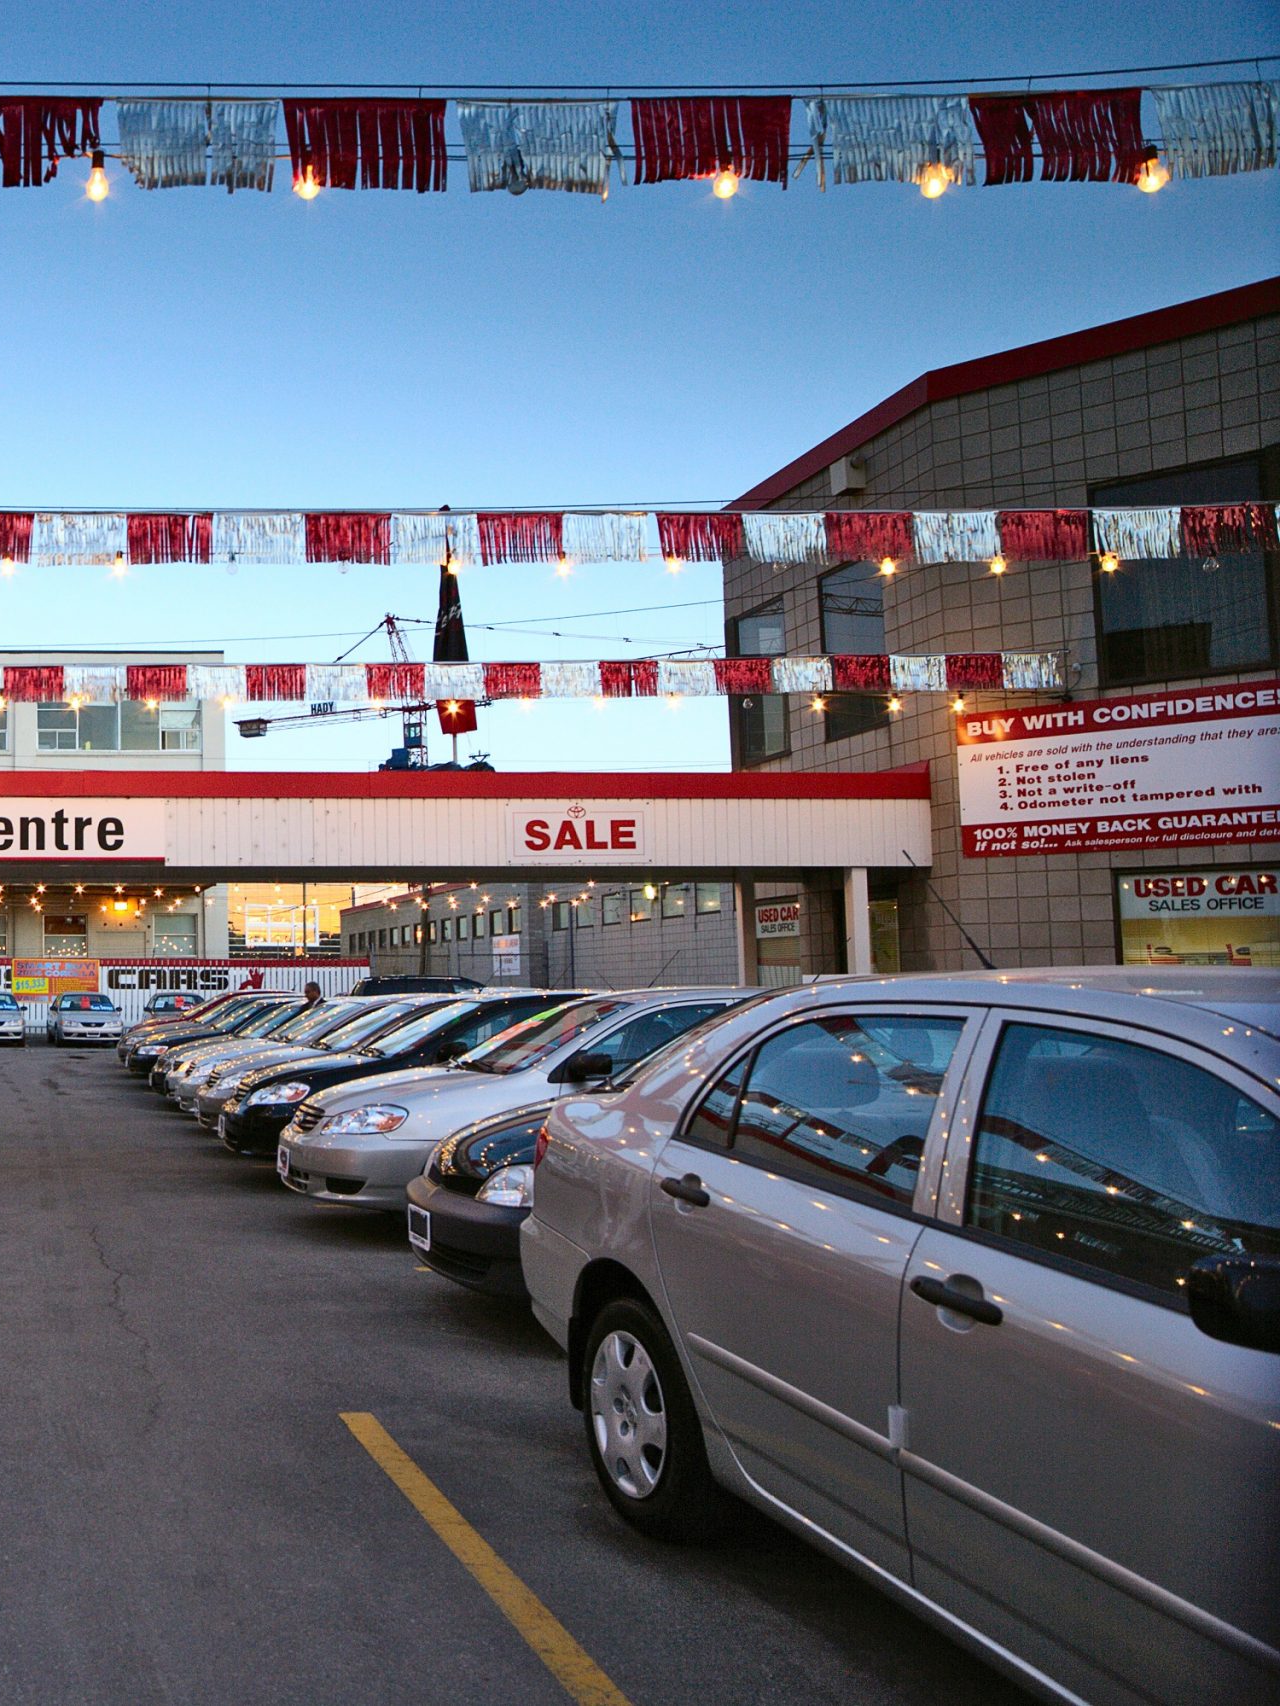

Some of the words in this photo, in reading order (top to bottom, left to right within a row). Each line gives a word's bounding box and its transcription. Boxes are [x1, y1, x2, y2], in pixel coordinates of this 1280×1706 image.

[311, 701, 334, 714] HADY
[967, 718, 1015, 736] BUY
[1023, 710, 1084, 731] WITH
[970, 752, 982, 763] All
[985, 749, 1024, 762] vehicles
[1027, 750, 1043, 758] are
[1046, 745, 1068, 756] sold
[1071, 742, 1092, 754] with
[1095, 740, 1113, 751] the
[1116, 733, 1196, 750] understanding
[1200, 730, 1222, 741] that
[1227, 728, 1254, 739] they
[998, 766, 1010, 774] 1.
[1016, 763, 1049, 773] Free
[1055, 759, 1070, 769] of
[1076, 757, 1103, 768] any
[1110, 755, 1149, 765] liens
[998, 778, 1011, 786] 2.
[1017, 776, 1042, 785] Not
[1048, 772, 1096, 783] stolen
[999, 790, 1012, 798] 3.
[1017, 788, 1042, 797] Not
[1063, 779, 1136, 794] write-off
[1000, 802, 1013, 811] 4.
[1018, 797, 1094, 810] Odometer
[1100, 793, 1126, 804] not
[1133, 787, 1215, 802] tampered
[1222, 784, 1263, 795] with
[524, 820, 637, 851] SALE
[973, 827, 1018, 840] 100%
[1023, 822, 1091, 837] MONEY
[1097, 818, 1152, 833] BACK
[1158, 810, 1280, 829] GUARANTE
[975, 841, 987, 851] If
[991, 840, 1016, 851] not
[1084, 836, 1143, 847] salesperson
[1145, 835, 1159, 843] for
[1162, 833, 1178, 842] full
[1180, 831, 1233, 841] disclosure
[1236, 829, 1256, 838] and
[1134, 877, 1206, 898] USED
[1215, 874, 1279, 896] CAR
[758, 908, 779, 924] USED
[780, 906, 799, 921] CAR
[1148, 899, 1201, 912] SALES
[1207, 897, 1264, 910] OFFICE
[761, 923, 777, 934] SALES
[778, 922, 795, 932] OFFICE
[107, 969, 229, 990] CARS
